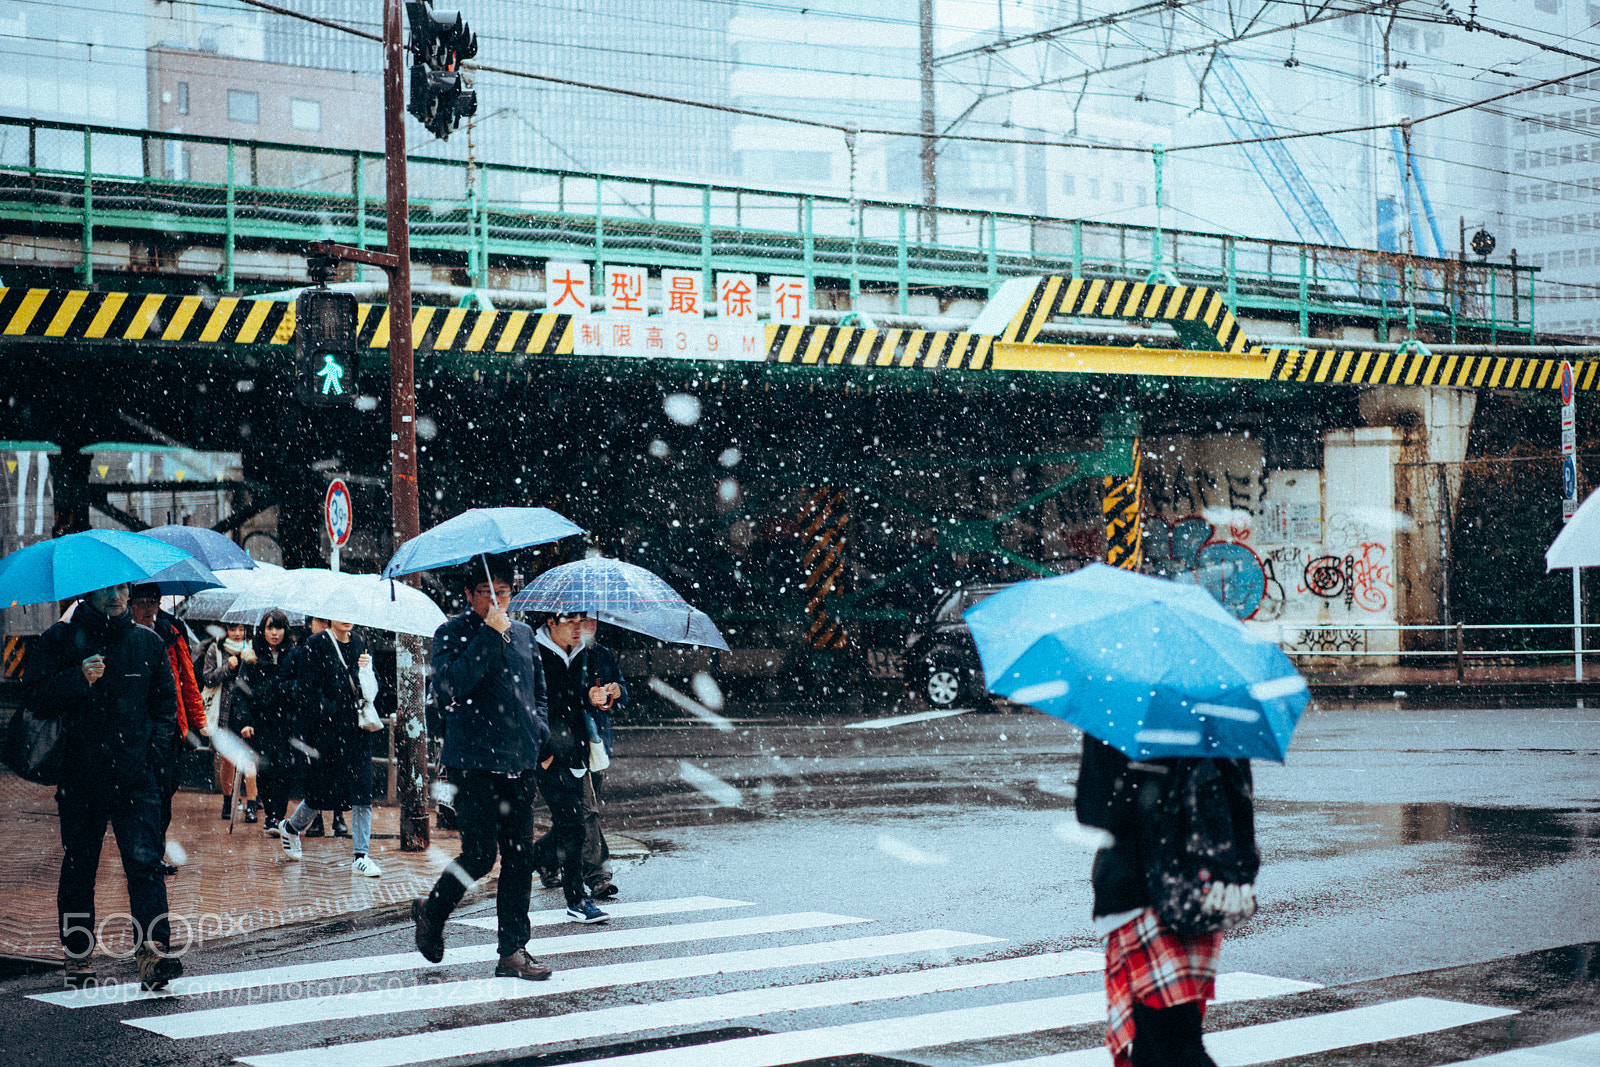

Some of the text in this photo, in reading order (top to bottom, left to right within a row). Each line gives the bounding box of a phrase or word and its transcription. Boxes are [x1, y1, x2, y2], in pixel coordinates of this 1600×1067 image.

[552, 269, 803, 319] 大型最徐行
